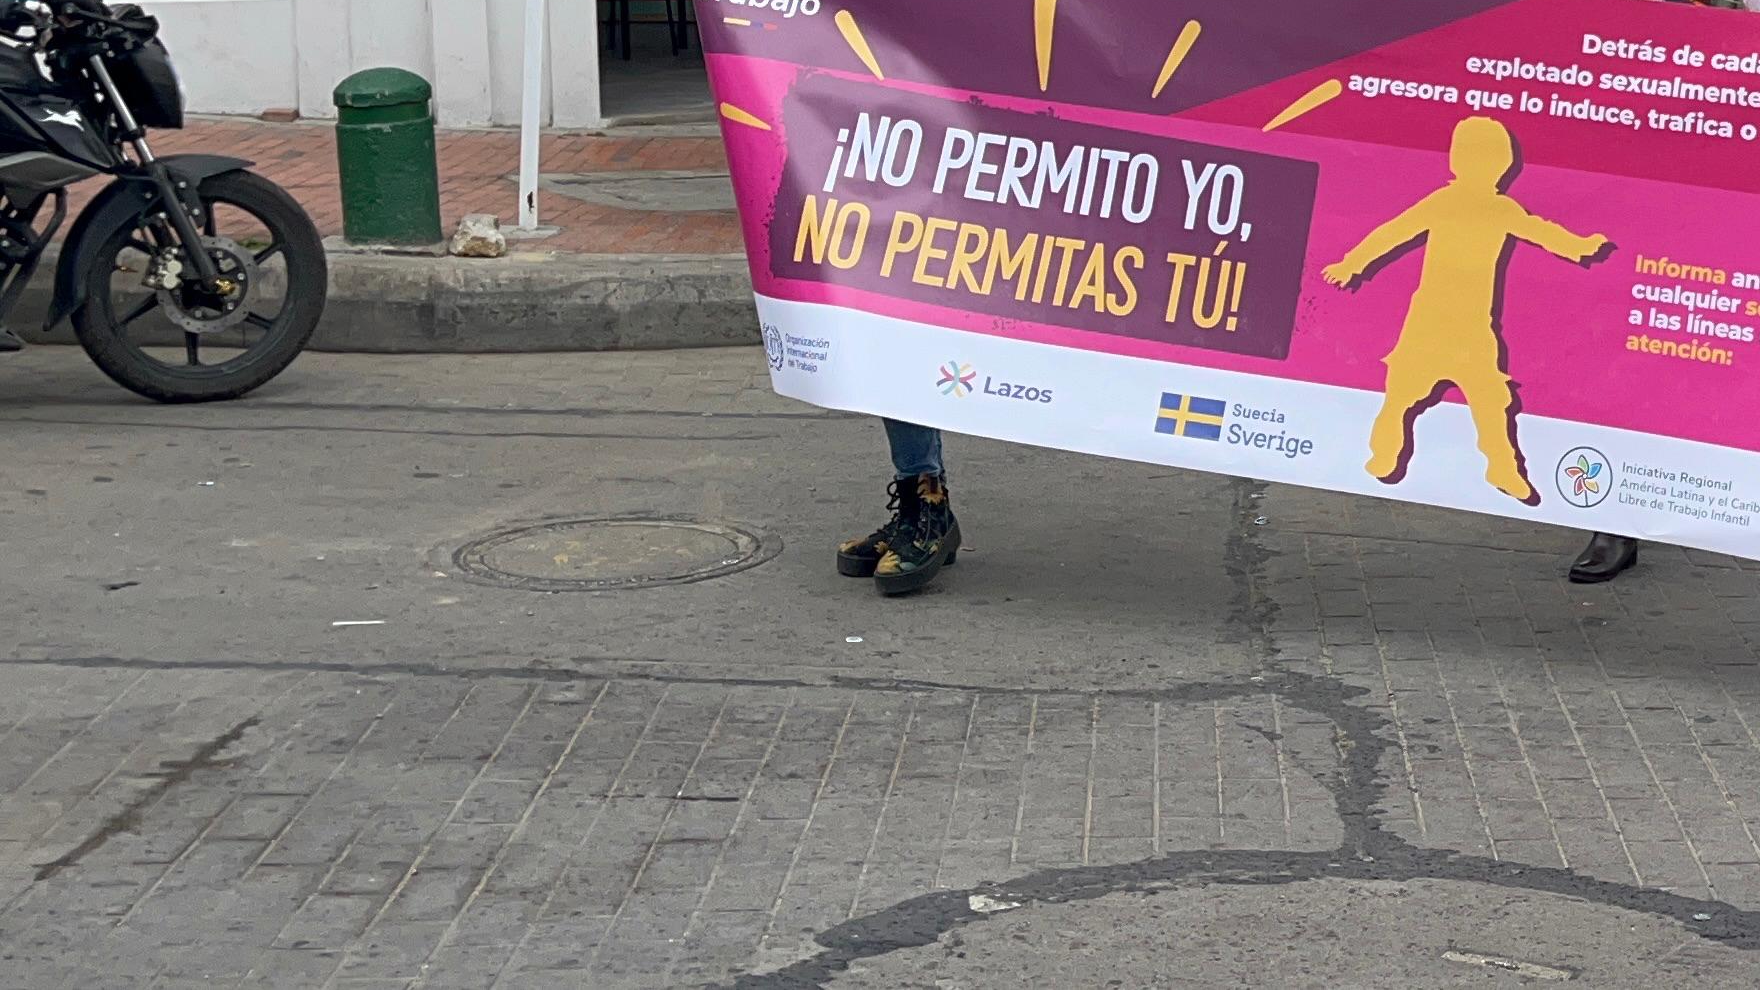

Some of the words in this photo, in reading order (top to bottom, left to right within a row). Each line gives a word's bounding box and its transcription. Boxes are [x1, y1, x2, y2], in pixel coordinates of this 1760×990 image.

[1581, 33, 1667, 64] Detrás
[1672, 45, 1705, 68] de
[1464, 56, 1594, 87] explotado
[1347, 72, 1459, 104] agresora
[1464, 86, 1514, 111] que
[1519, 91, 1544, 114] lo
[1549, 94, 1642, 131] induce,
[1647, 106, 1734, 139] trafica
[1740, 122, 1757, 141] o
[822, 111, 923, 194] ¡NO
[931, 126, 1160, 224] PERMITO
[1180, 158, 1253, 243] YO,
[793, 194, 870, 270] NO
[879, 211, 1145, 317] PERMITAS
[1164, 239, 1248, 333] TÚ!
[1634, 254, 1726, 286] Informa
[1631, 282, 1741, 314] cualquier
[785, 332, 830, 349] Organización
[1628, 309, 1644, 327] a
[1648, 307, 1682, 332] las
[1686, 313, 1755, 344] líneas
[1625, 332, 1735, 367] atención:
[982, 375, 1054, 405] Lazos
[1231, 402, 1286, 426] Suecia
[1226, 422, 1314, 460] Sverige
[1619, 477, 1668, 497] América
[1669, 485, 1706, 503] Latina
[1708, 495, 1716, 506] y
[1717, 495, 1729, 507] el
[1621, 461, 1677, 482] Iniciativa
[1679, 471, 1734, 492] Regional
[1617, 492, 1648, 508] Libre
[1649, 497, 1665, 511] de
[1667, 501, 1709, 520] Trabajo
[1710, 508, 1751, 528] Infantil
